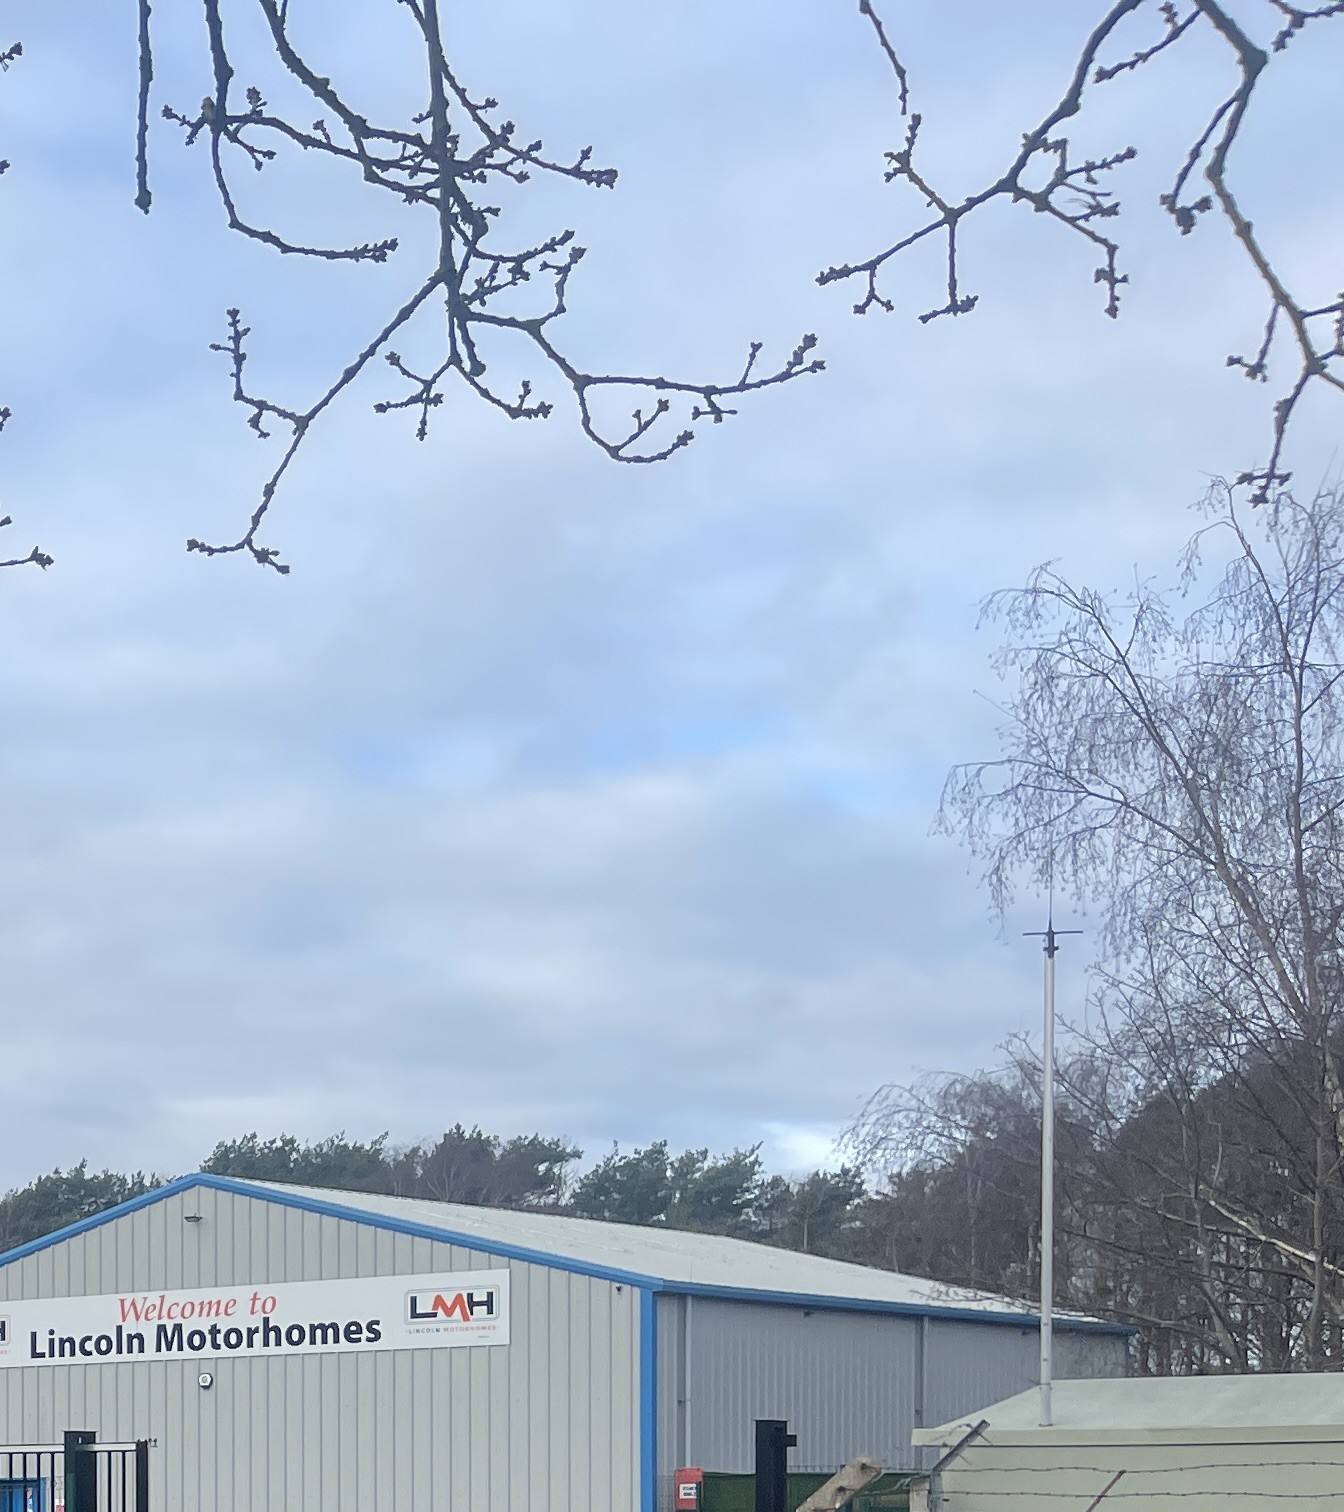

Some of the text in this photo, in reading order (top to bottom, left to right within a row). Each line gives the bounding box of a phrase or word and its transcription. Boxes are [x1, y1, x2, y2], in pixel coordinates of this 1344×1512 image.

[118, 1291, 277, 1323] Welcome to
[410, 1291, 494, 1322] LMH
[30, 1317, 382, 1359] Lincoln Motorhomes
